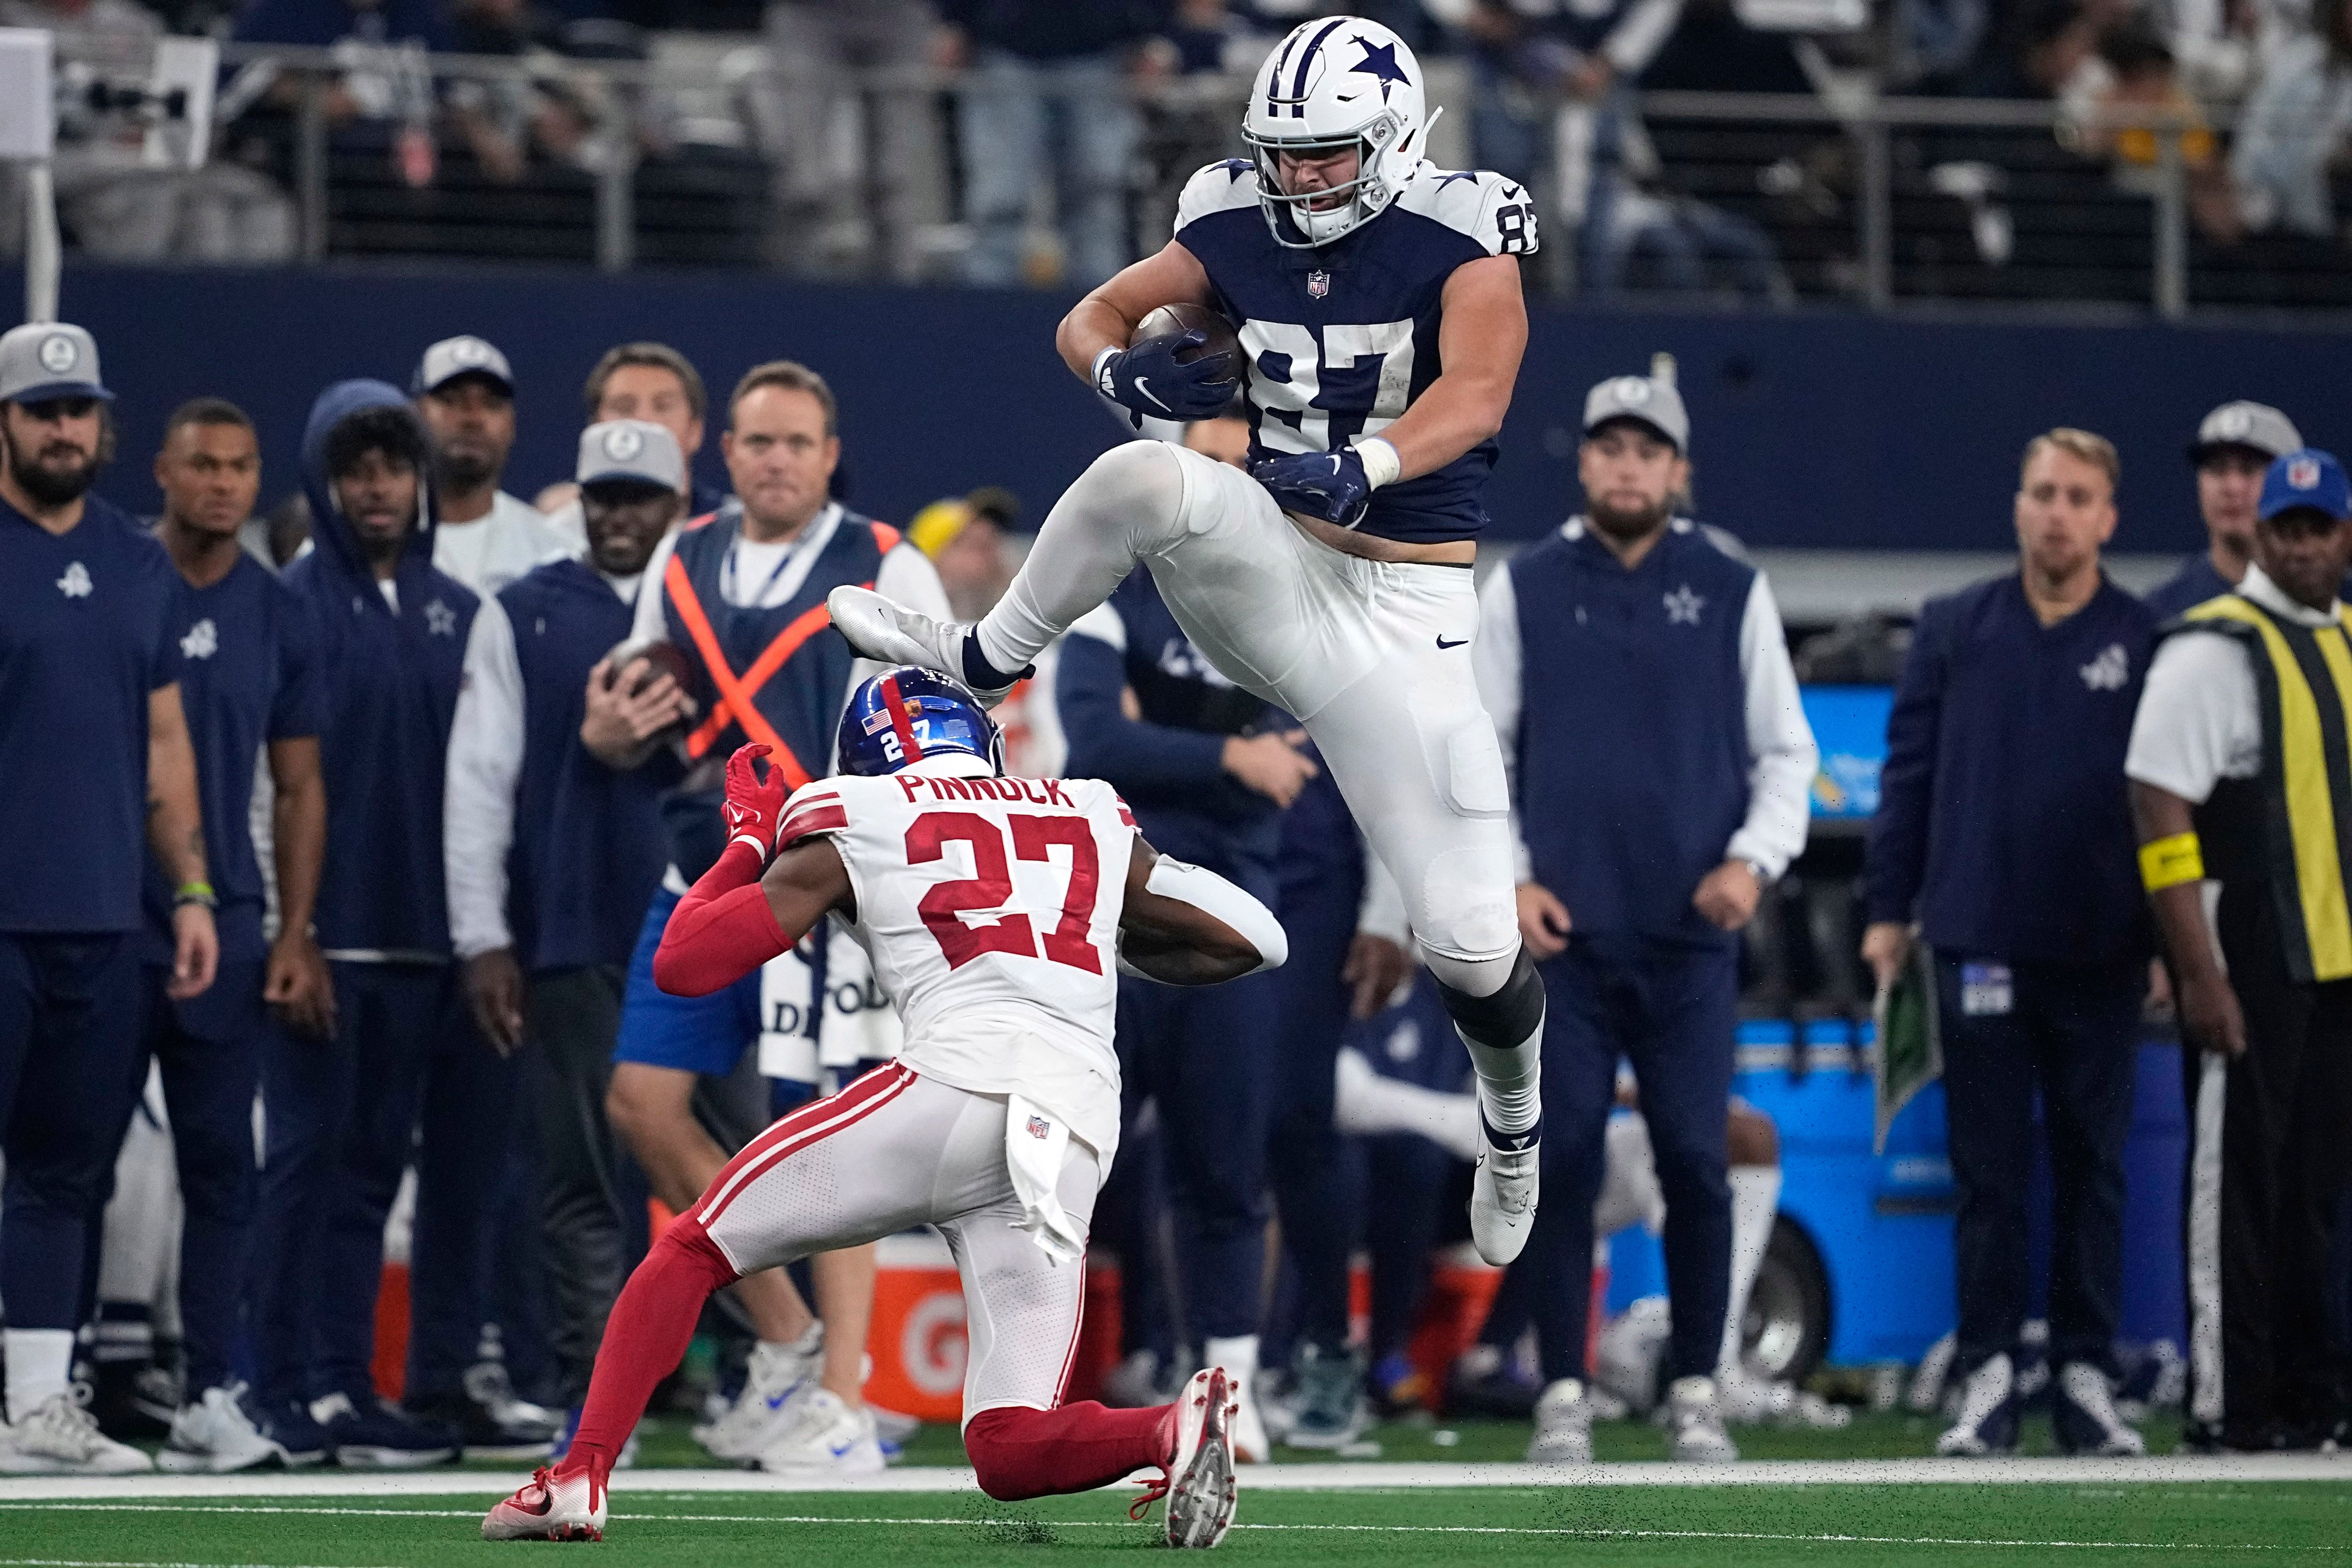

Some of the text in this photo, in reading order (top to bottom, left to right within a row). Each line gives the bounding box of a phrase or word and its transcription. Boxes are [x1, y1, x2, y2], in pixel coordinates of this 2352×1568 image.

[1311, 283, 1324, 293] NFL
[1238, 317, 1415, 455] 87
[895, 775, 1076, 808] PINNOCK
[905, 812, 1103, 977] 27
[1028, 1122, 1045, 1138] NFL
